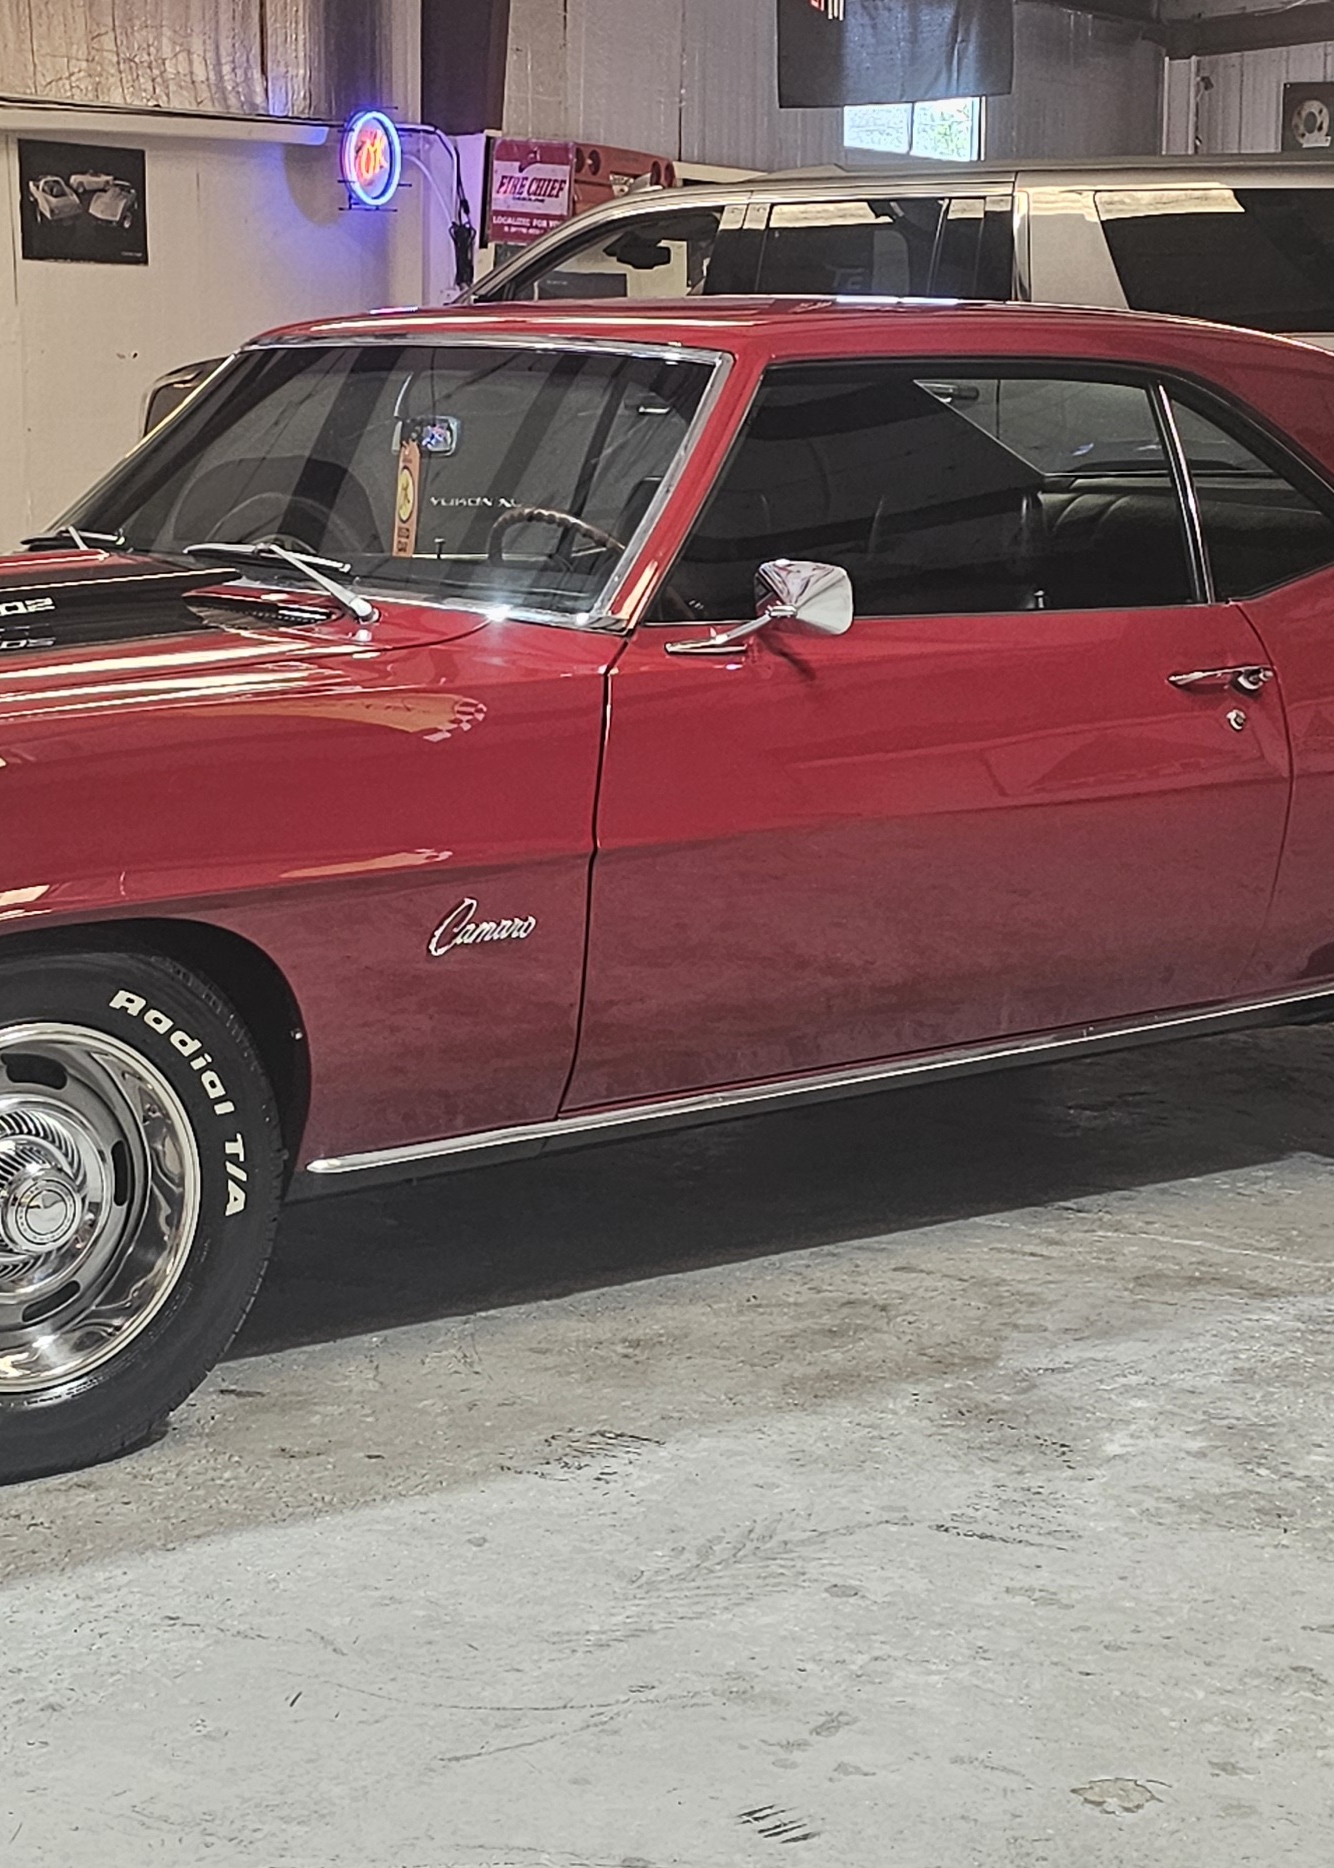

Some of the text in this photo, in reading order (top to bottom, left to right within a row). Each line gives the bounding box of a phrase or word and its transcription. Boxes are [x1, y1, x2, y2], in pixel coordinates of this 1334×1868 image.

[496, 174, 567, 199] FIRE CHIEF
[428, 897, 537, 957] Camaro
[108, 989, 249, 1217] Radial T/A
